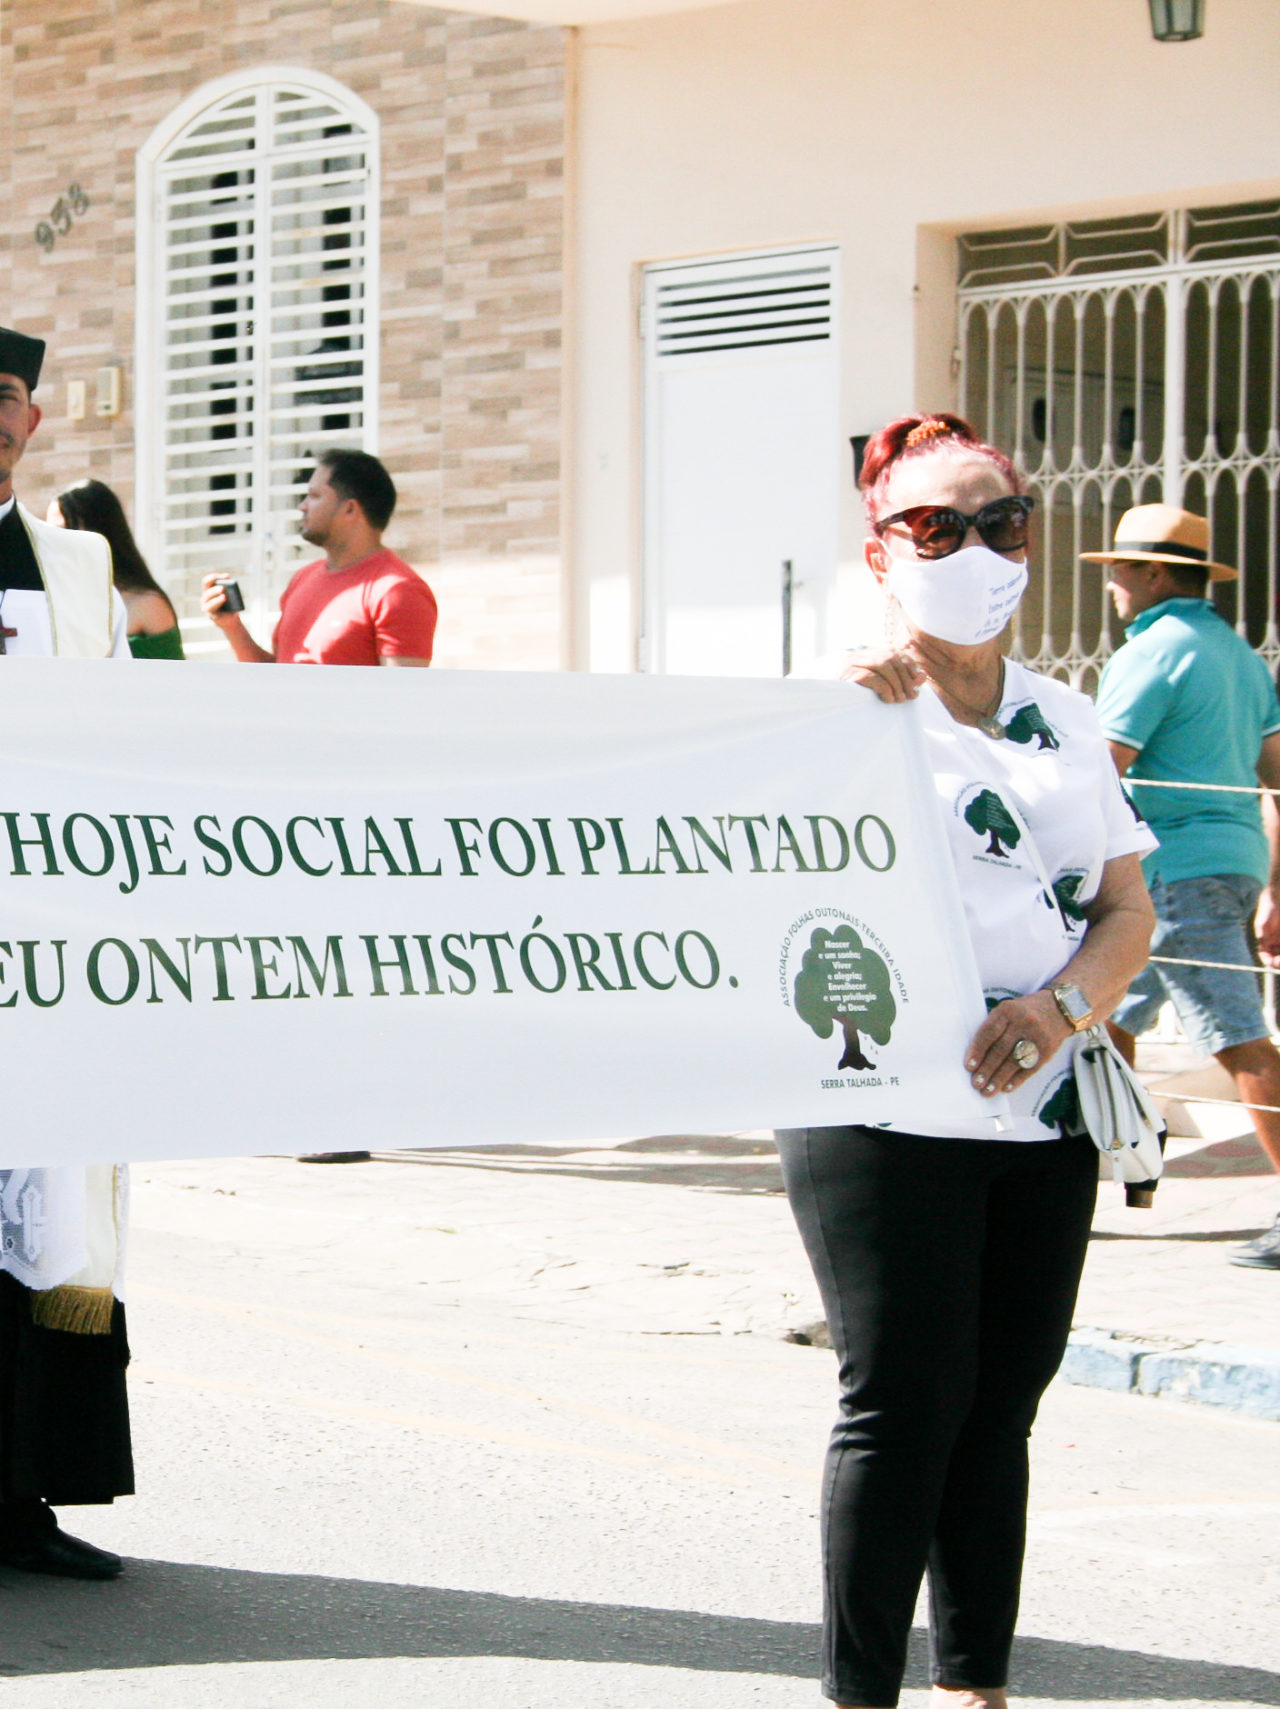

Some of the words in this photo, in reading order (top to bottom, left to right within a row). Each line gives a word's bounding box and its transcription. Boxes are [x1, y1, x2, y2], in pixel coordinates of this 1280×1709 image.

[193, 814, 442, 877] SOCIAL
[444, 816, 566, 877] FOI
[567, 812, 897, 876] PLANTADO
[824, 940, 850, 949] Nascer
[86, 933, 354, 1006] ONTEM
[359, 915, 738, 997] HISTÓRICO.
[778, 937, 792, 1007] ASSOCIAÇÃO
[788, 910, 814, 938] FOLHAS
[893, 968, 909, 1004] IDADE
[824, 952, 836, 960] um
[832, 961, 852, 969] Viver
[837, 1003, 847, 1012] de
[820, 1079, 845, 1089] SERRA
[846, 1077, 882, 1088] TALHADA
[890, 1076, 900, 1086] PE
